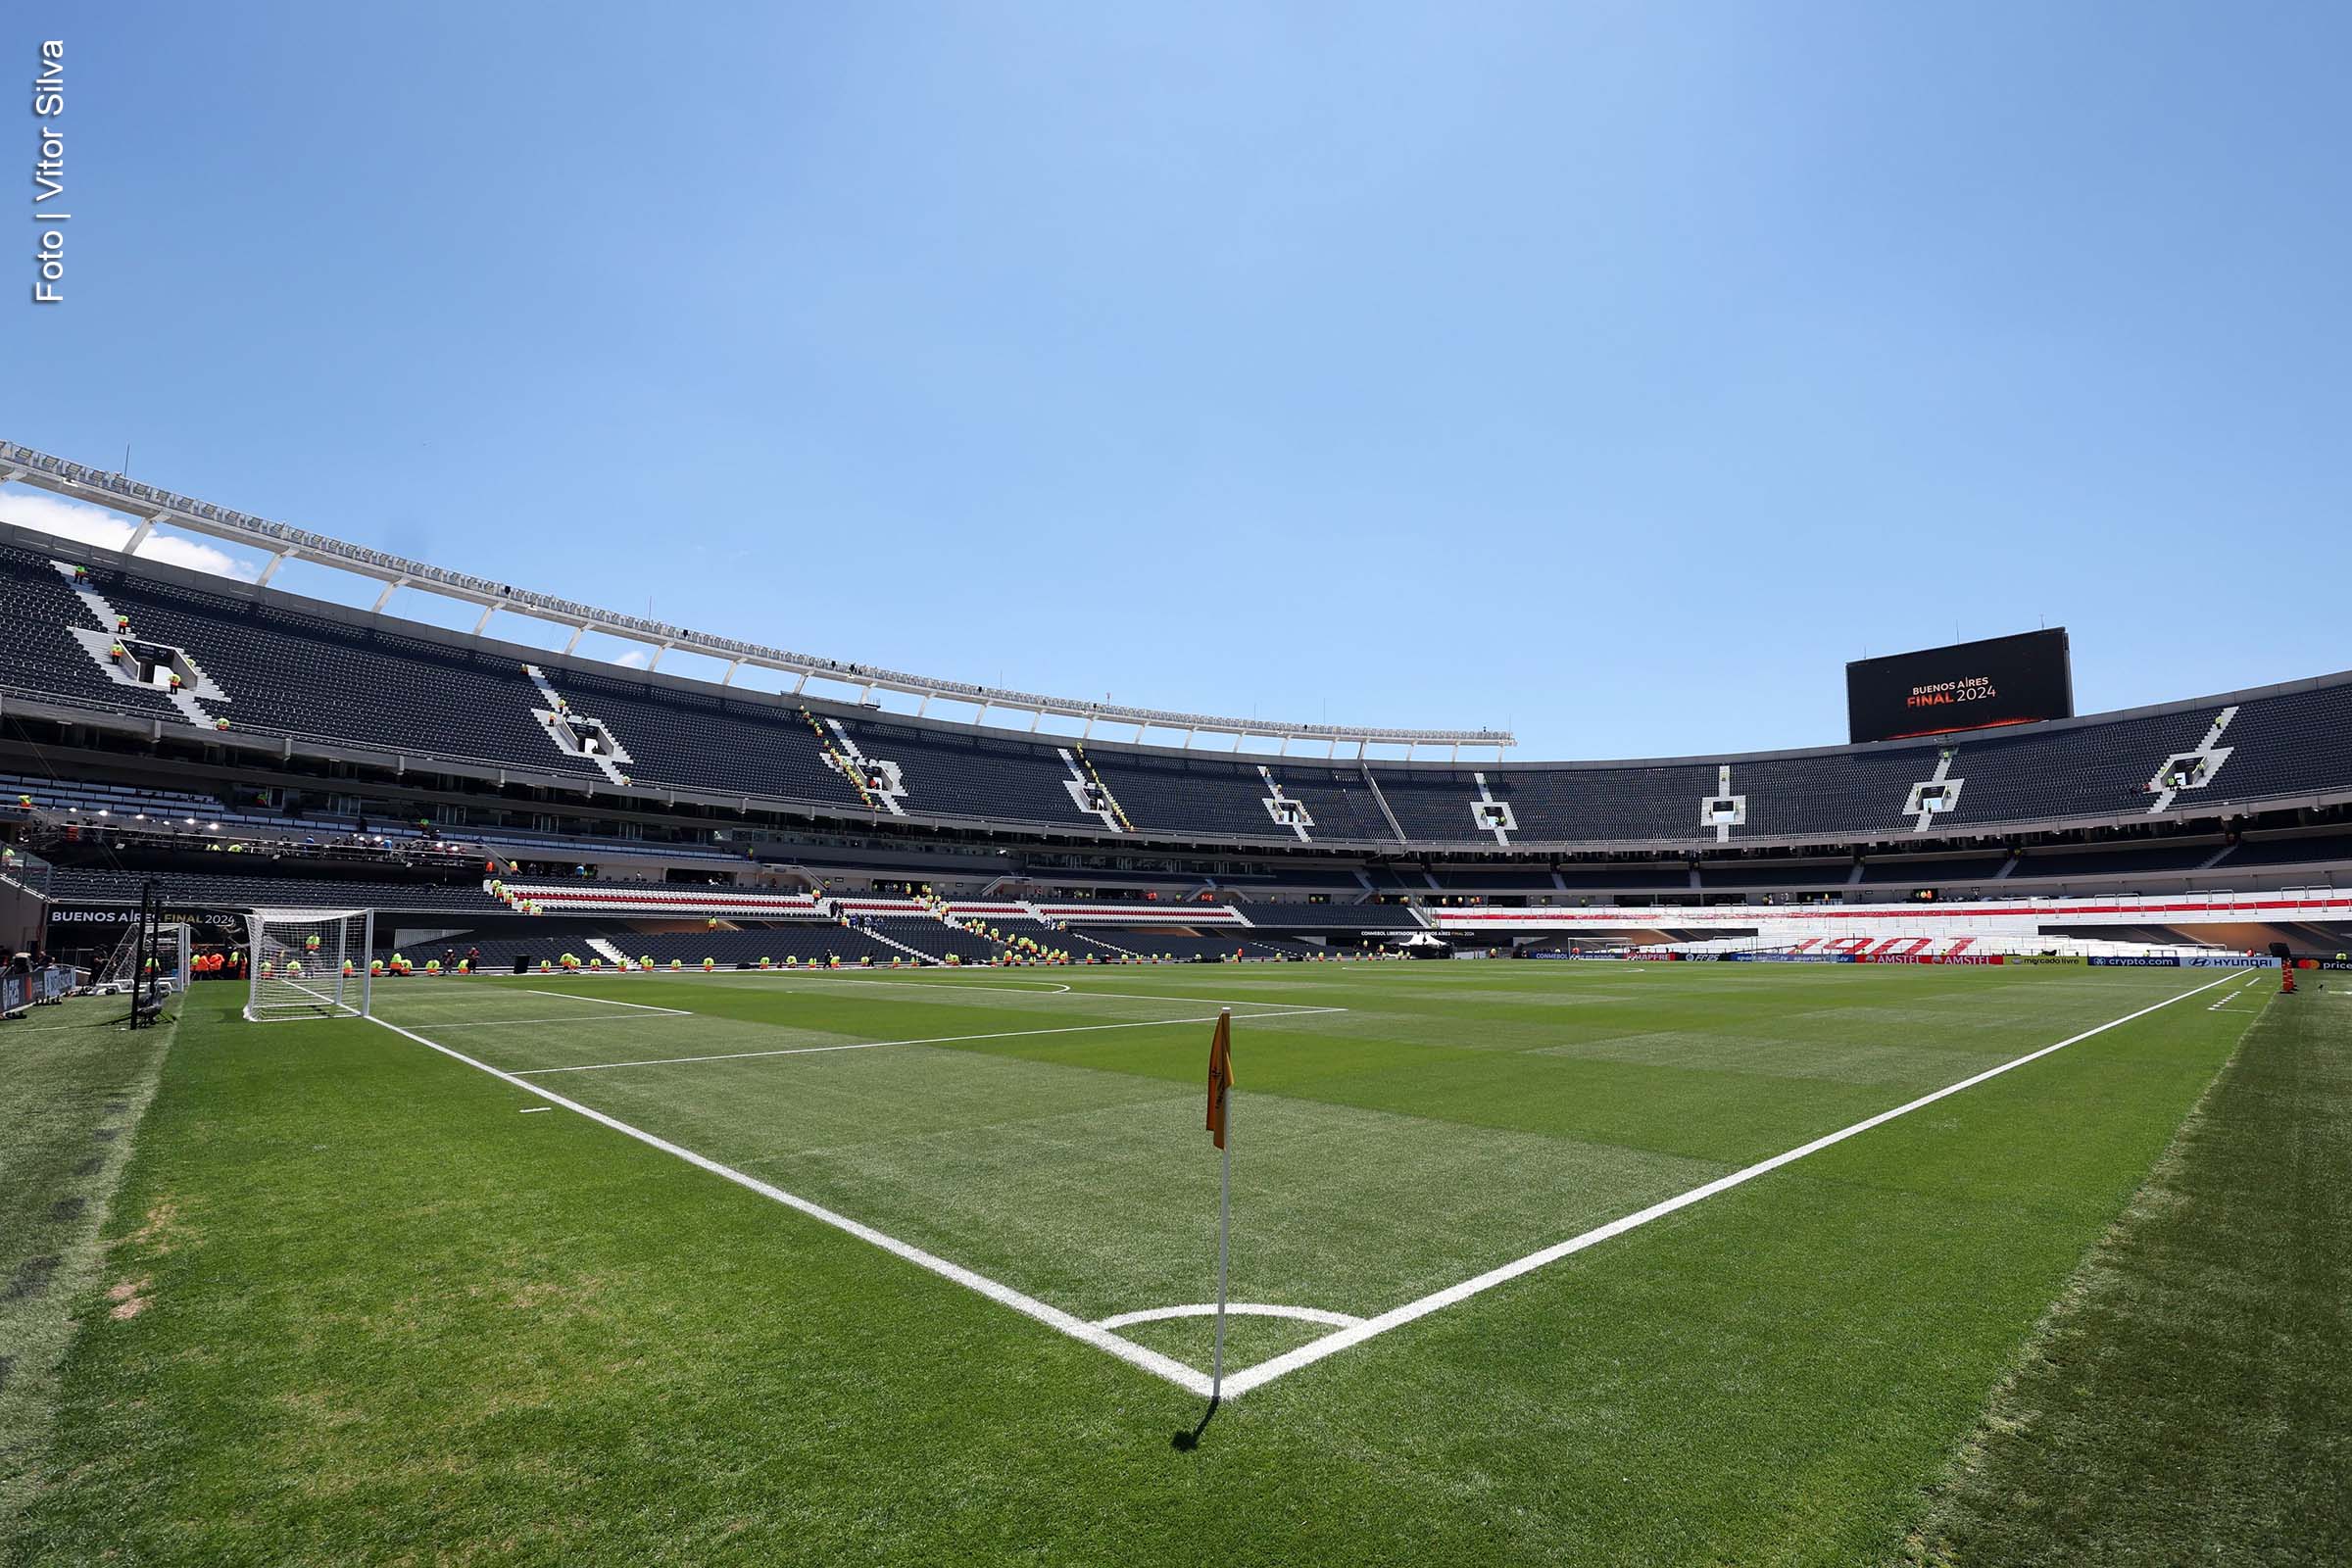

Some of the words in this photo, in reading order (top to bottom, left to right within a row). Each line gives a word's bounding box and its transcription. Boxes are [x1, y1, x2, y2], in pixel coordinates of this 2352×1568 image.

[1912, 682, 1956, 696] BUENOS
[1907, 692, 1954, 708] FINAL
[1956, 685, 1996, 702] 2024
[52, 911, 116, 922] BUENOS
[164, 913, 203, 923] FINAL
[205, 914, 235, 924] 2024
[1877, 956, 1920, 964] AMSTEL
[1944, 956, 1990, 965] AMSTEL
